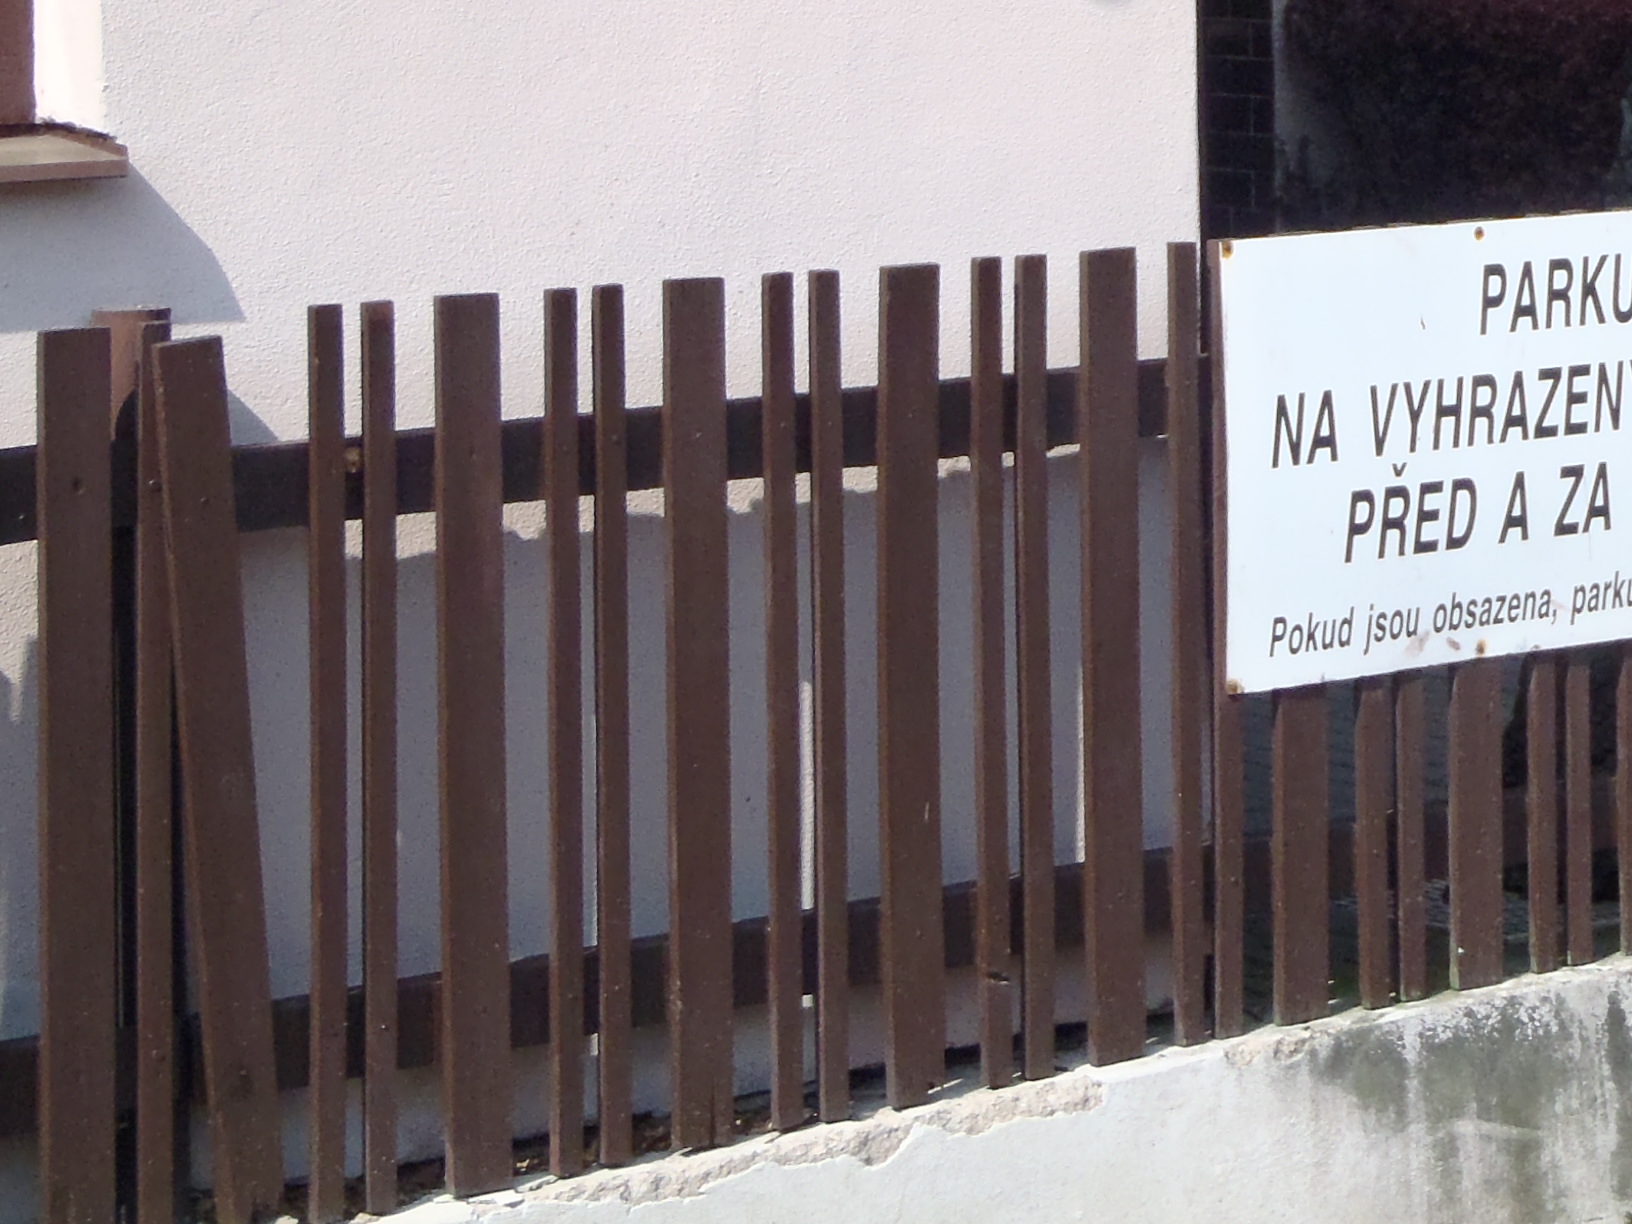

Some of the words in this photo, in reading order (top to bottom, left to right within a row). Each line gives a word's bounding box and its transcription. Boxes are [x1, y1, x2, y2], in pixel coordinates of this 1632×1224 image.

[1271, 389, 1339, 469] NA
[1344, 462, 1477, 564] PŘED
[1498, 471, 1530, 544] A
[1553, 461, 1611, 537] ZA
[1269, 613, 1354, 659] Pokud
[1363, 610, 1420, 656] jsou
[1432, 588, 1559, 636] obsazena,
